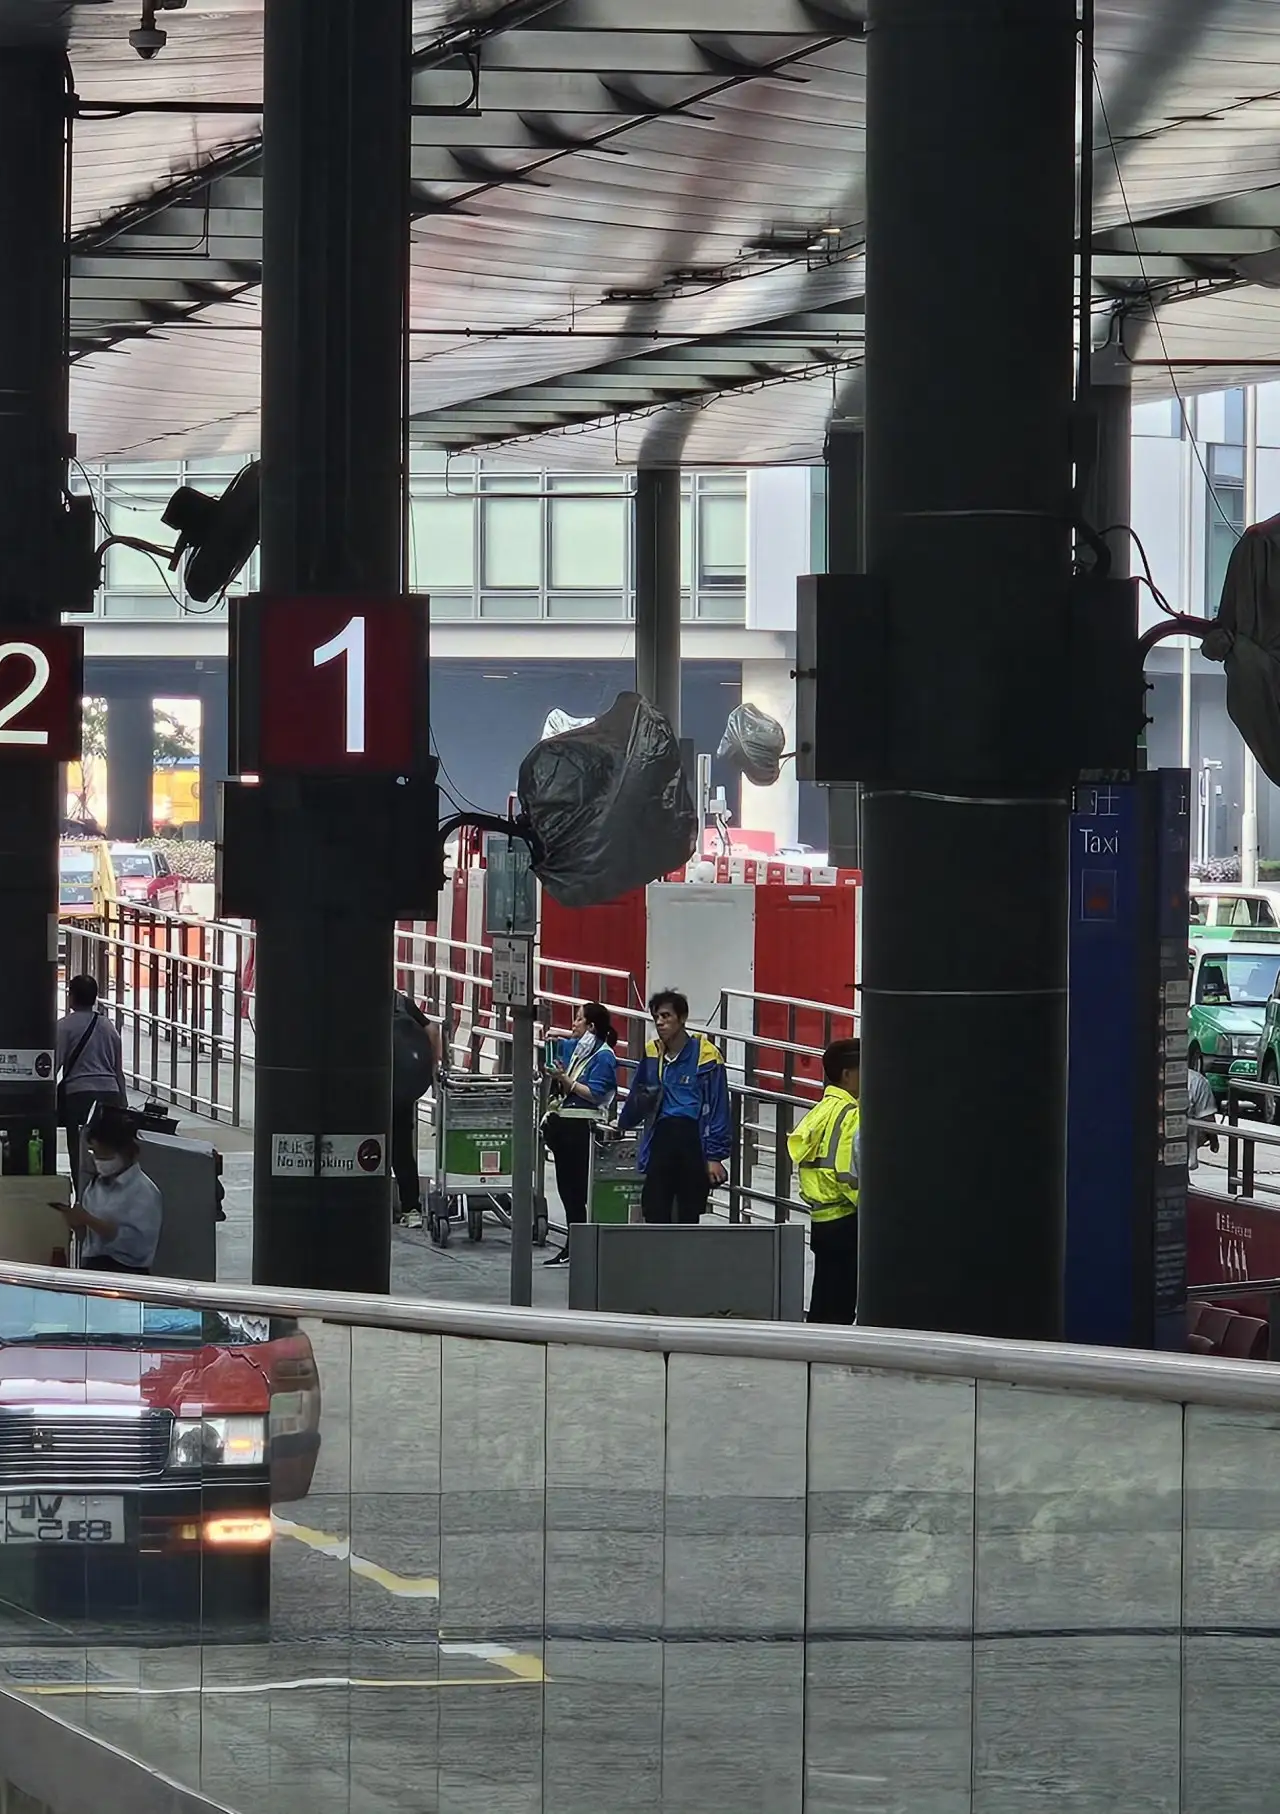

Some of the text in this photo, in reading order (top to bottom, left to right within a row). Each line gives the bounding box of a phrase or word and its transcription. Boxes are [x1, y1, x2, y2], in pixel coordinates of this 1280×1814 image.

[312, 616, 366, 753] 1
[1079, 828, 1119, 854] Taxi
[277, 1156, 294, 1168] No
